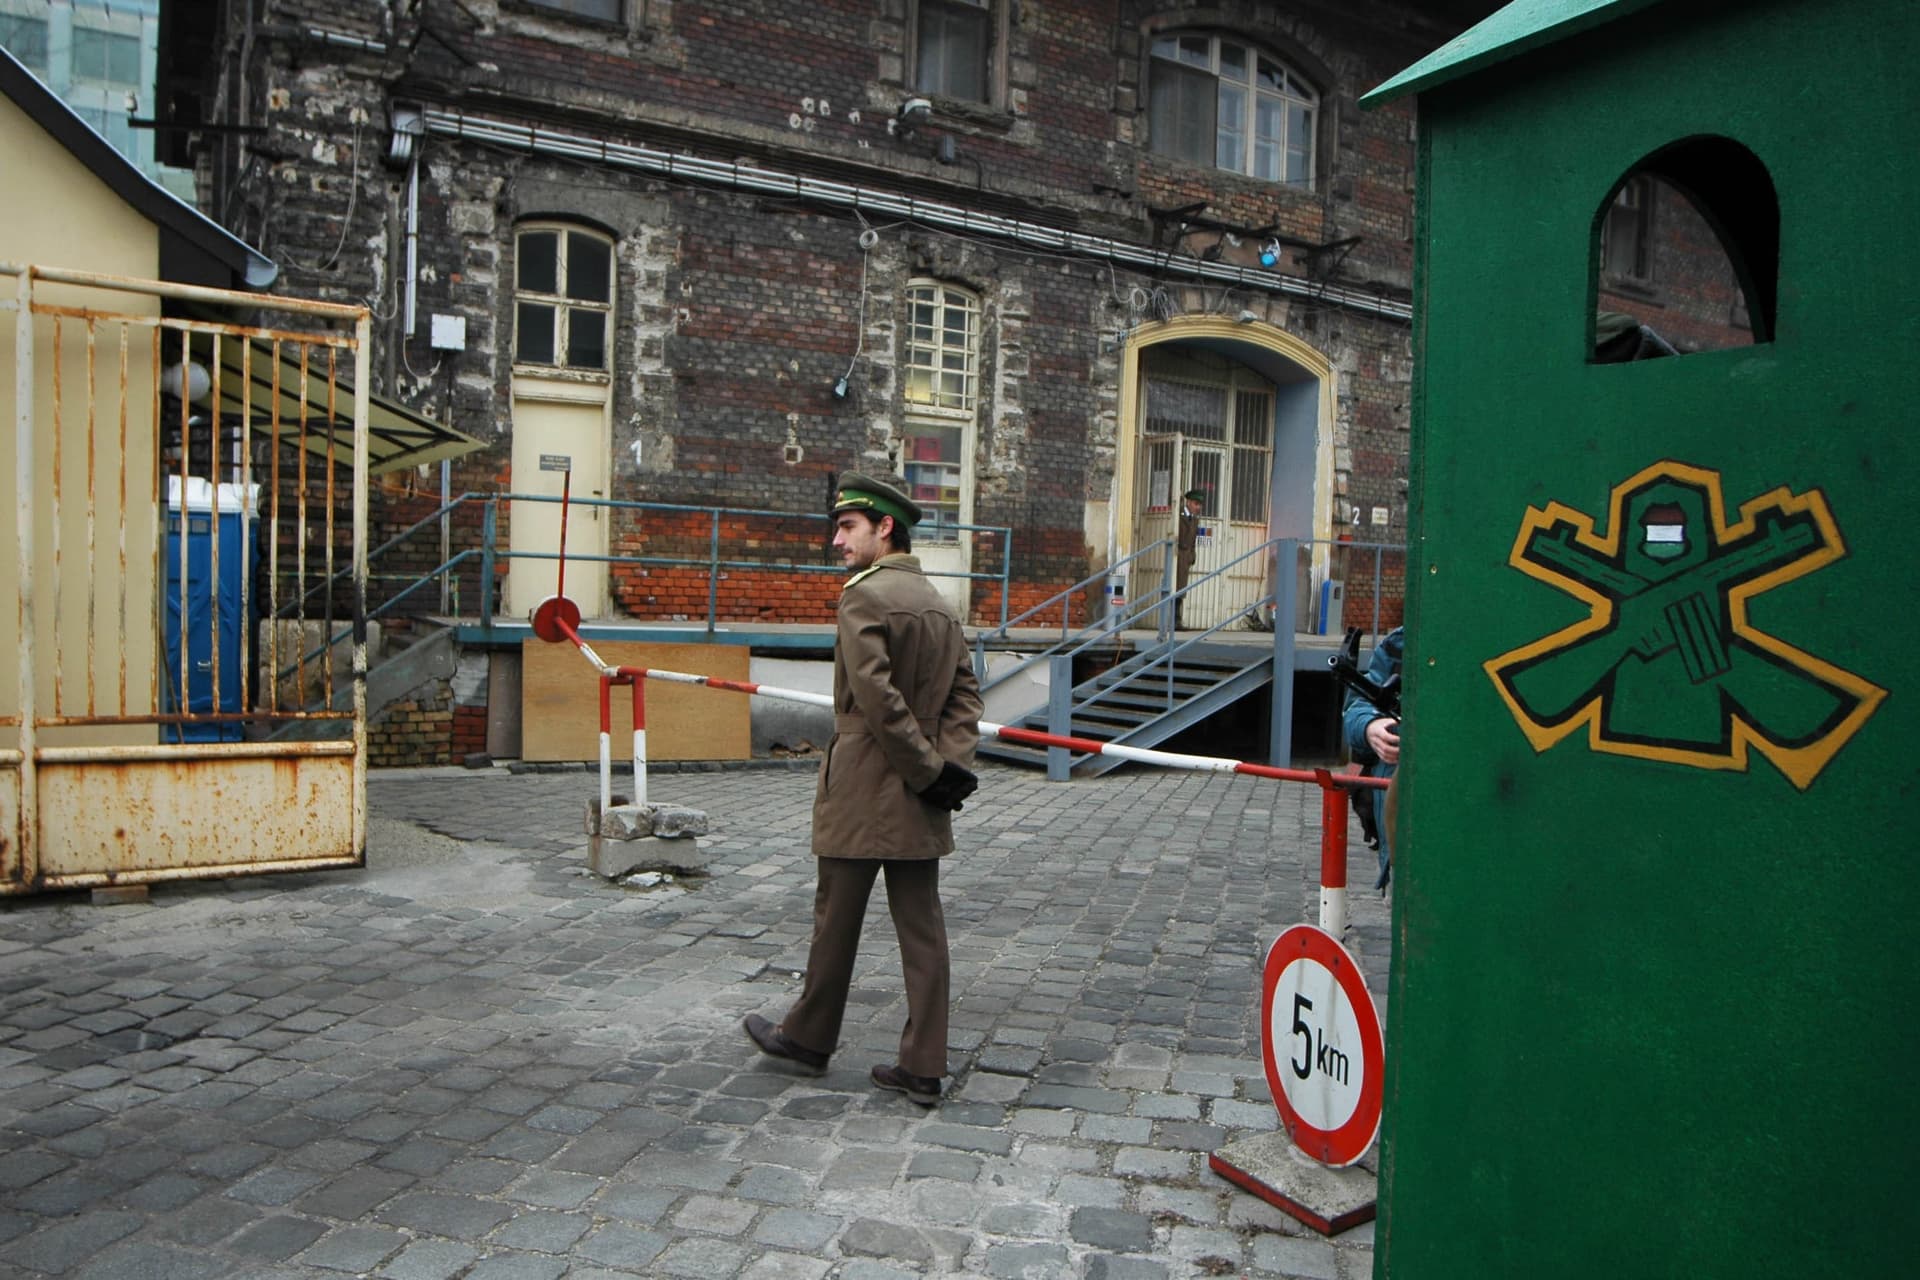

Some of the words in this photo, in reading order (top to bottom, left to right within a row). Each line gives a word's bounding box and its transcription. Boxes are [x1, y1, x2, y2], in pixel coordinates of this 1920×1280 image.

[630, 439, 642, 465] 1
[1352, 506, 1361, 525] 2
[1291, 992, 1313, 1080] 5
[1317, 1027, 1349, 1086] km
